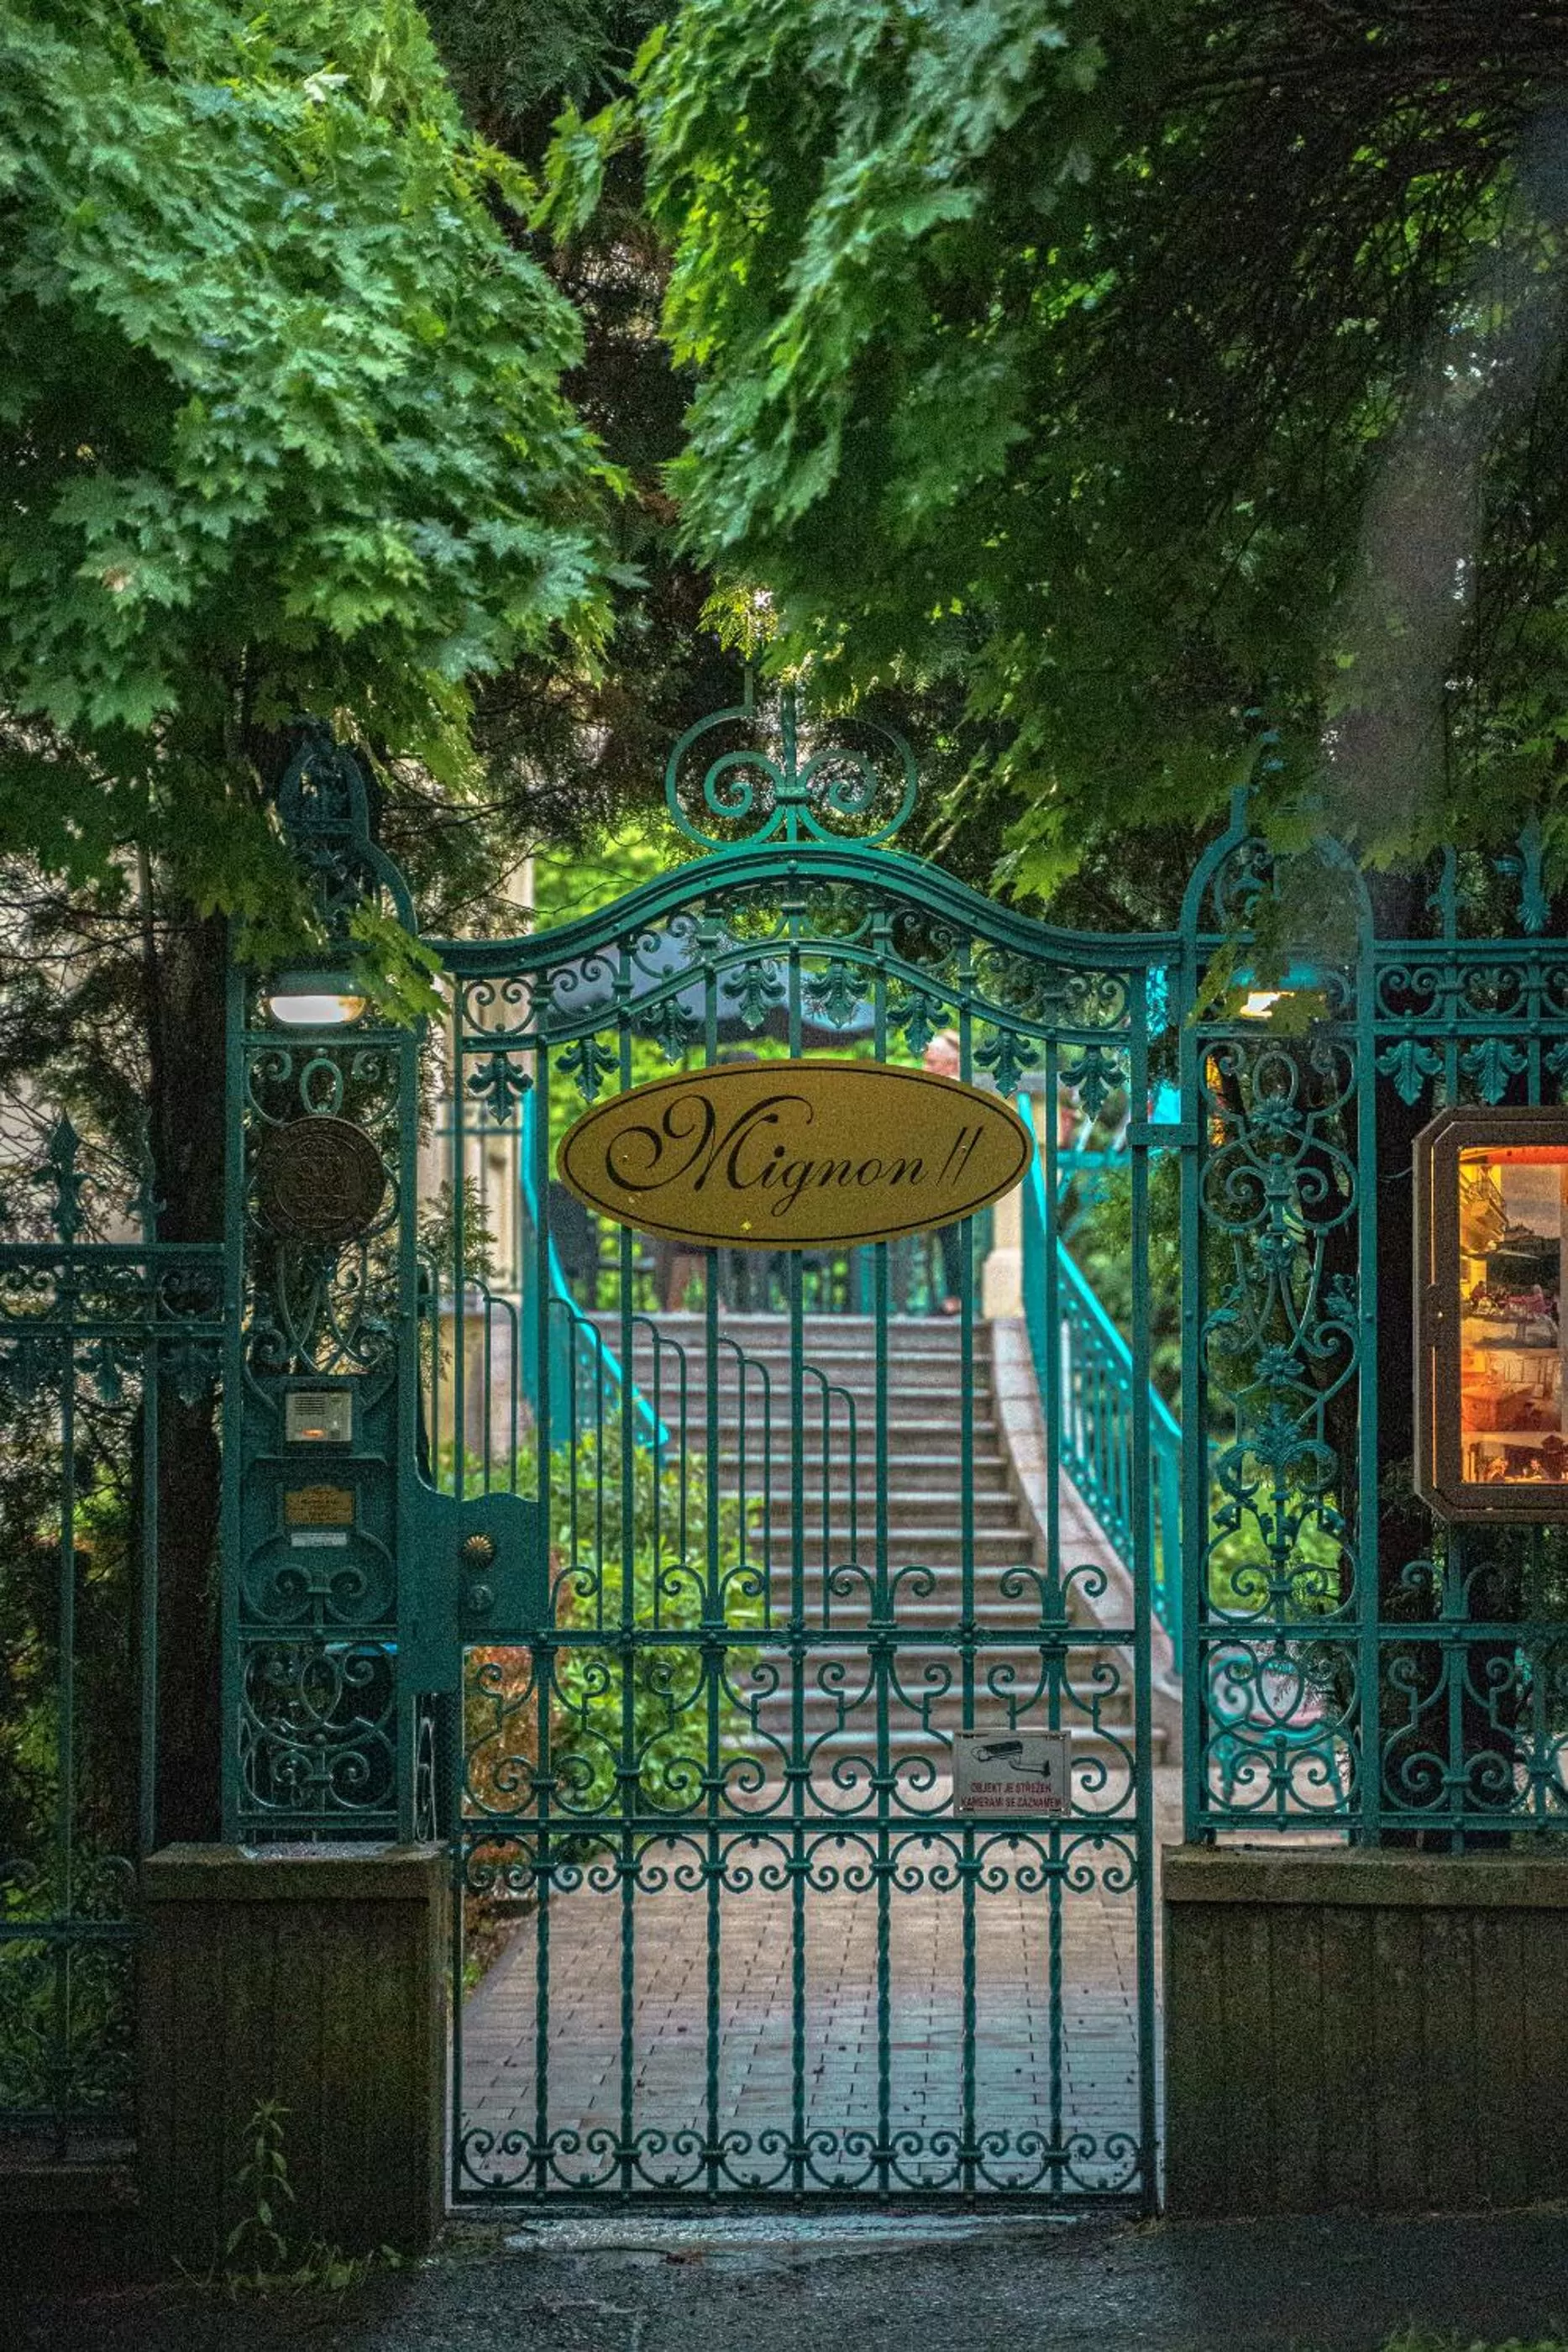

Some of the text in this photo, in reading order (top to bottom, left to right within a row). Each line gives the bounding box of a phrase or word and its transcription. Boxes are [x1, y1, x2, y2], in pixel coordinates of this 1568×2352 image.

[606, 1095, 928, 1217] Mignon
[971, 1782, 1002, 1793] OBJEKT
[1004, 1782, 1014, 1793] JE
[1005, 1797, 1016, 1807] SE
